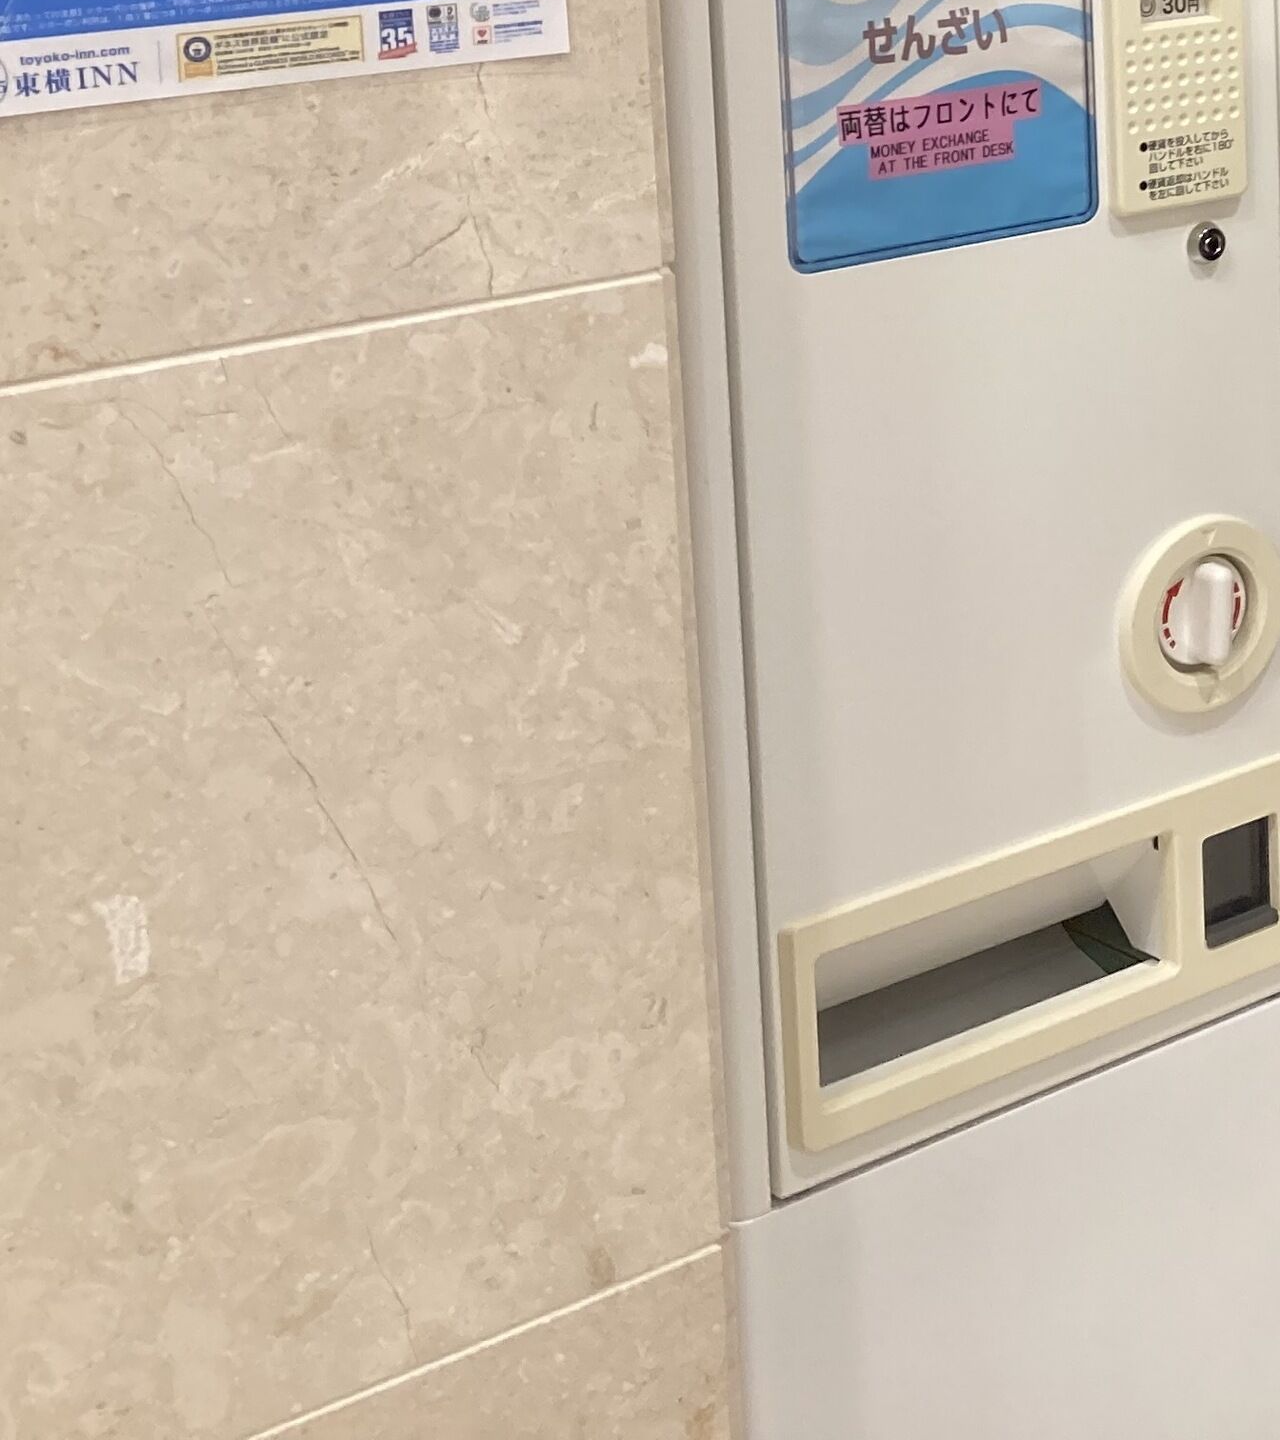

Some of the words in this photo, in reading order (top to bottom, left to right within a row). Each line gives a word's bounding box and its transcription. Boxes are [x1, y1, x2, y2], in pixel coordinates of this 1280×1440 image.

[863, 7, 1008, 64] せんざい
[13, 61, 139, 98] 東横INN
[839, 88, 1038, 141] 両替はフロントにて
[871, 140, 915, 158] MONEY
[923, 129, 990, 152] EXCHANGE
[878, 160, 897, 175] AT
[904, 155, 928, 171] THE
[934, 148, 976, 166] FRONT
[983, 141, 1014, 158] DESK
